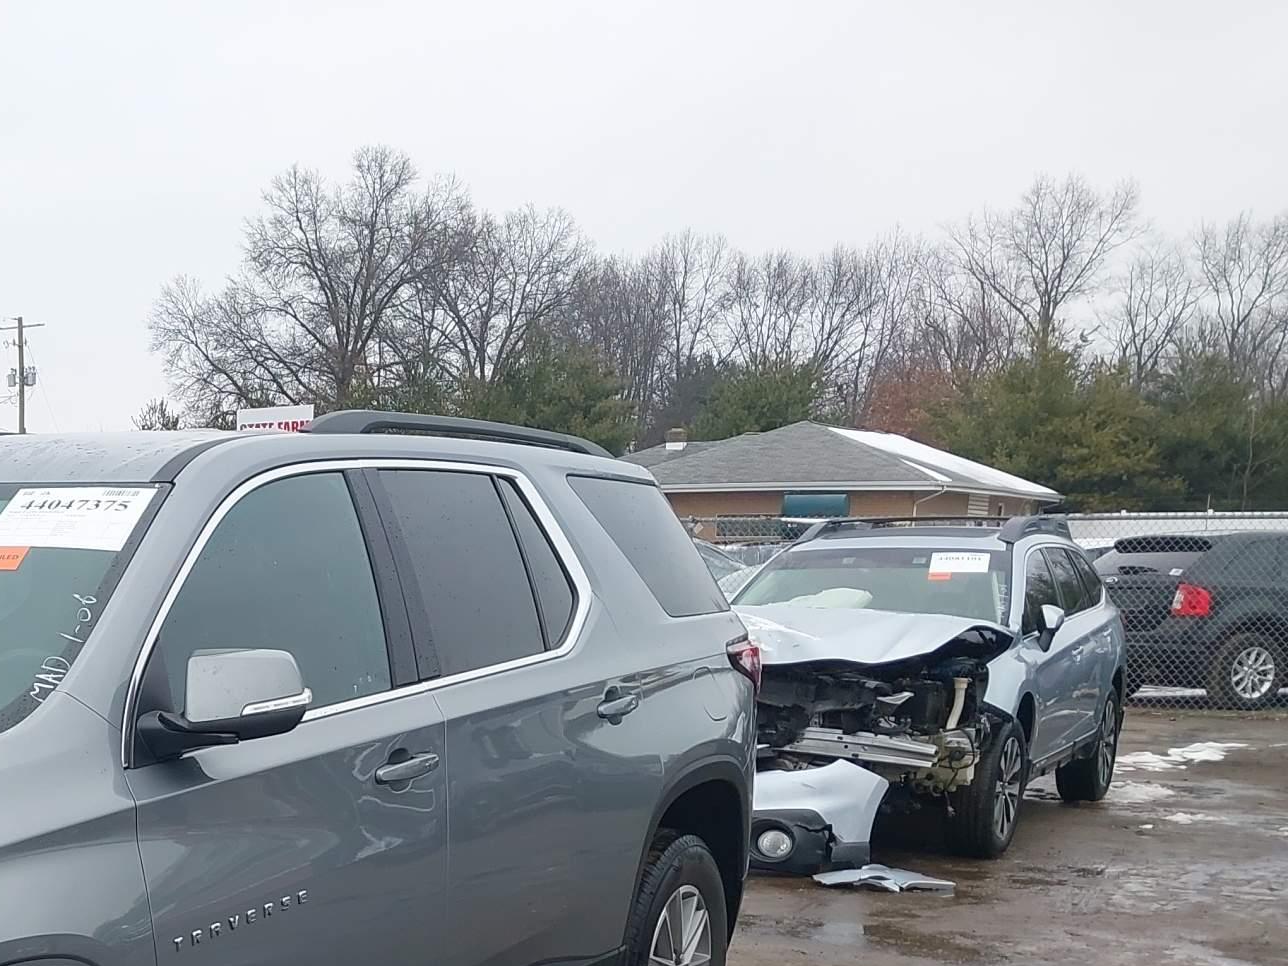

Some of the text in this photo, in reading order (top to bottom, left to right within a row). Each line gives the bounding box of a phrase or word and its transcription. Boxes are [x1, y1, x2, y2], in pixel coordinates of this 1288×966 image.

[20, 499, 133, 512] 44047375
[29, 655, 72, 703] MAD
[172, 889, 309, 952] TRAVERSE
